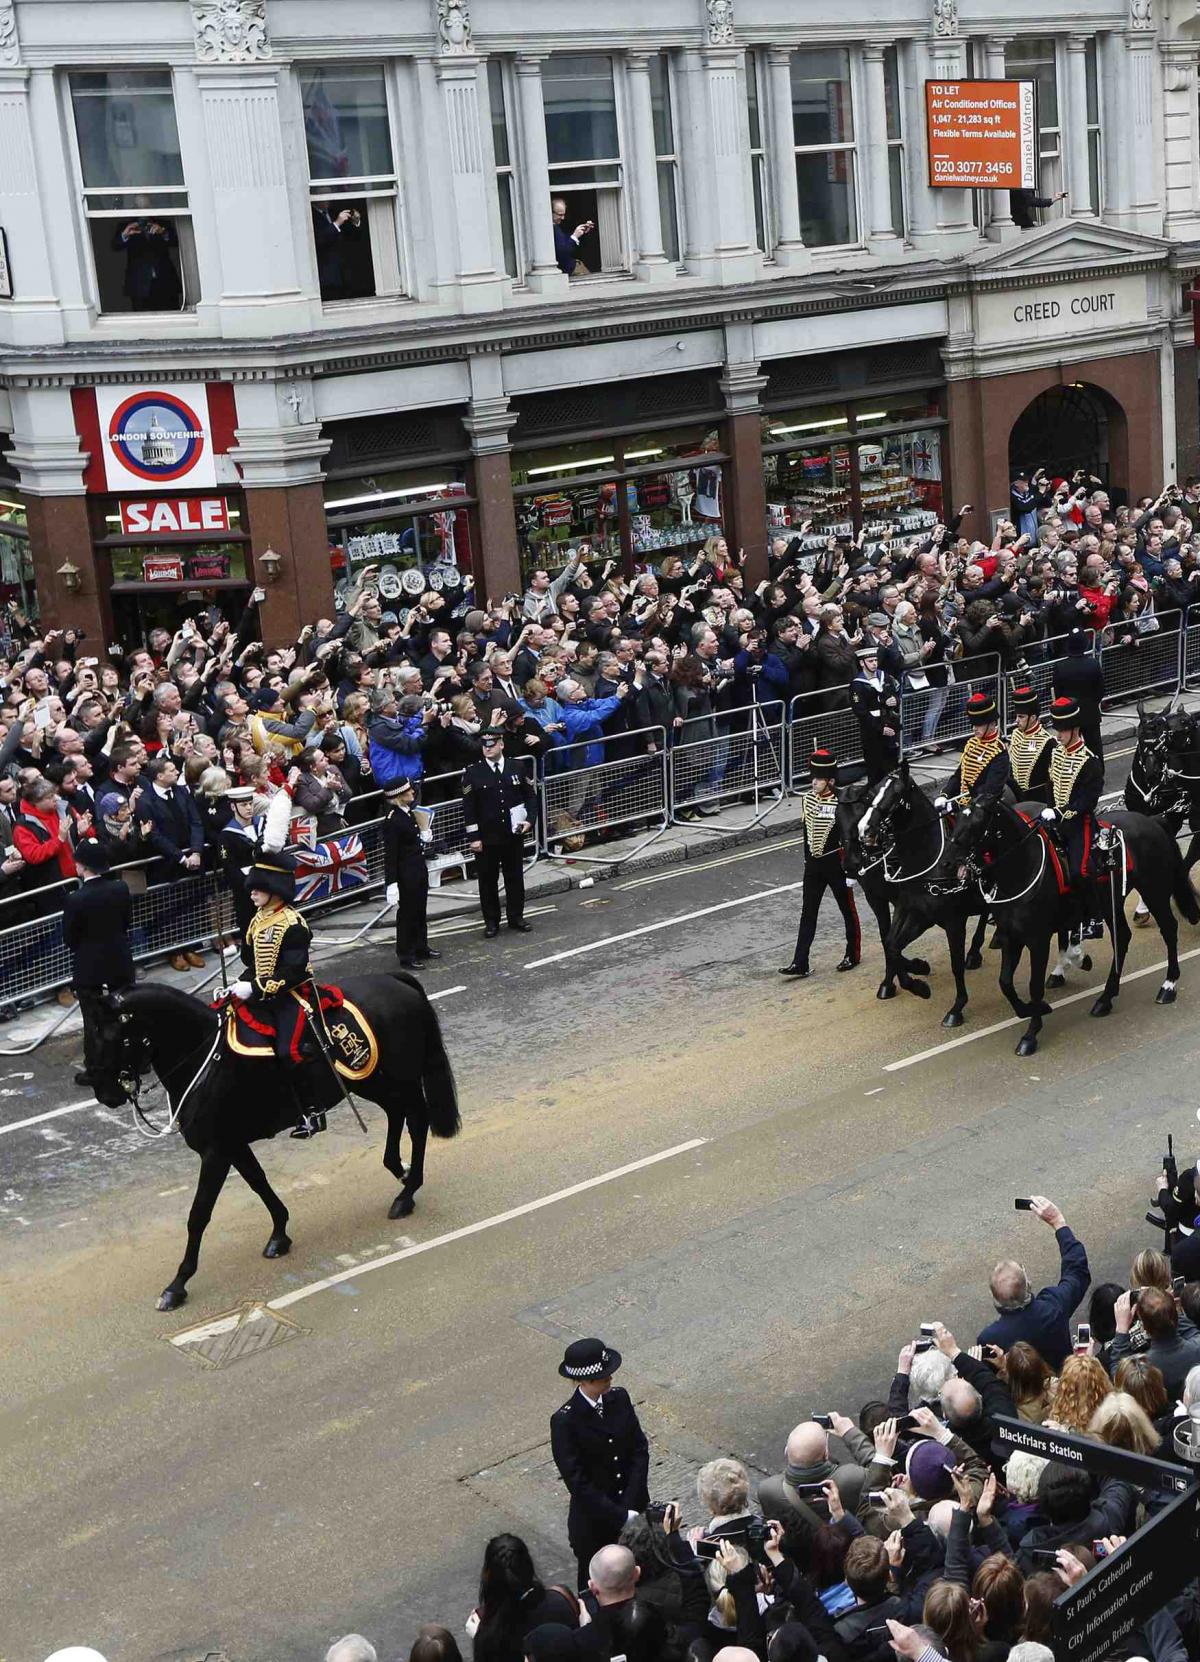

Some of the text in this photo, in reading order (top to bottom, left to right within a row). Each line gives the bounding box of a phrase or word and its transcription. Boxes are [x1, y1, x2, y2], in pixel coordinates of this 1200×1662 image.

[931, 86, 960, 95] TO LET
[931, 100, 1017, 109] Air Conditioned Offices
[932, 115, 951, 124] 1,047
[957, 115, 982, 124] 21,283
[983, 116, 993, 125] sq
[994, 115, 1001, 124] ft
[933, 129, 1016, 138] Flexible Terms Available
[1023, 87, 1034, 183] Daniel Watney
[934, 161, 1013, 174] 020 3077 3456
[934, 173, 998, 184] danielwatney.co.uk
[1013, 293, 1116, 323] CREED COURT
[107, 430, 205, 443] LONDON SOUVENIRS
[126, 501, 224, 532] SALE
[999, 1426, 1083, 1462] Blackfriars Station
[1066, 1555, 1132, 1621] St Paul's Cathedral
[1068, 1570, 1153, 1650] City Information Centre
[1112, 1617, 1135, 1643] Bridge
